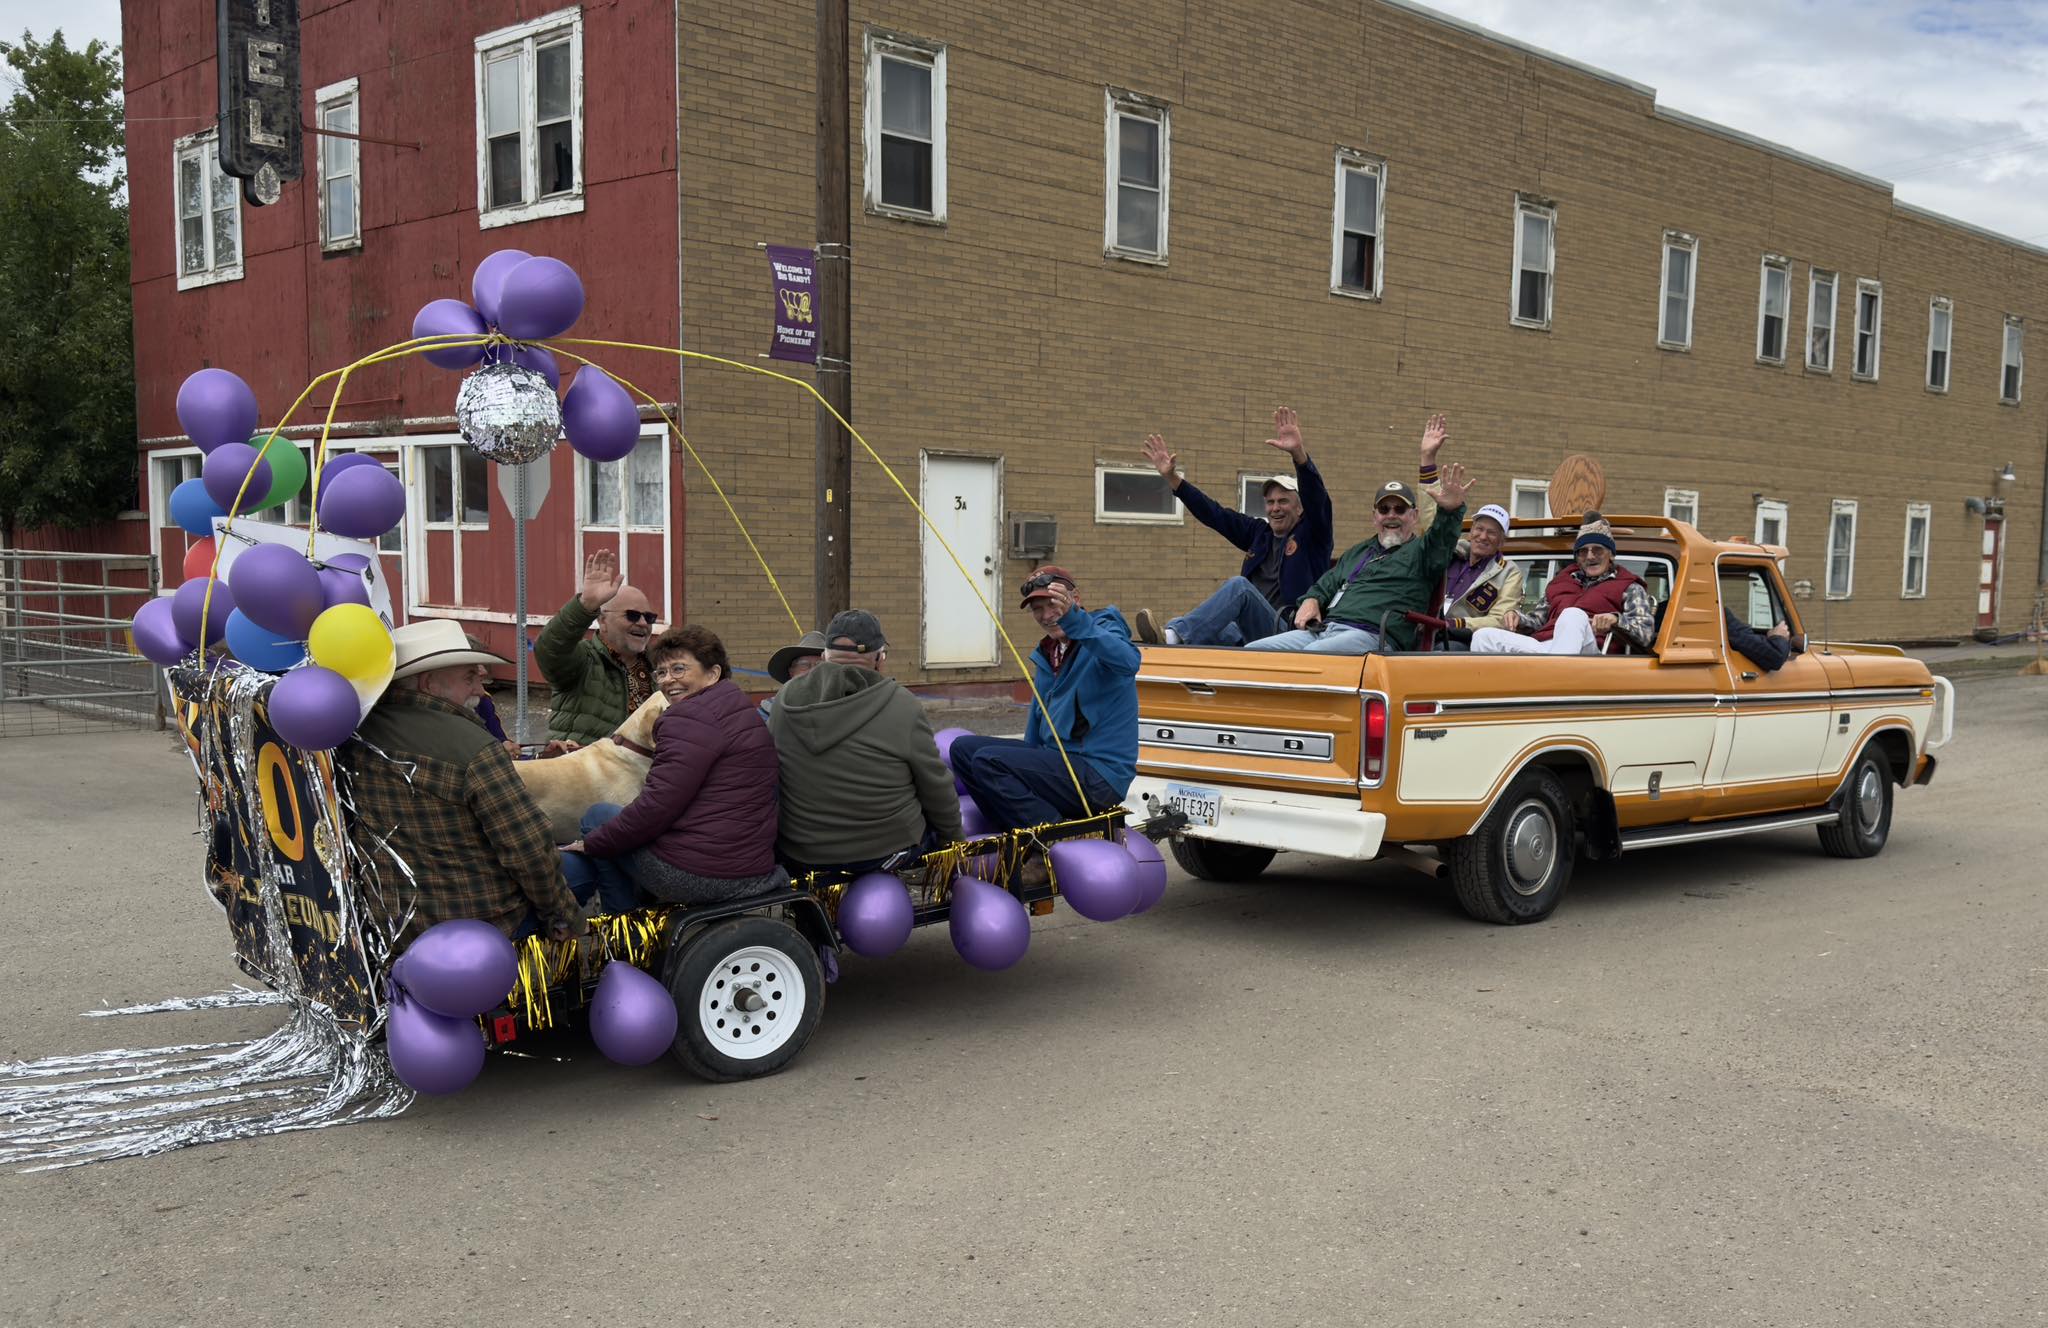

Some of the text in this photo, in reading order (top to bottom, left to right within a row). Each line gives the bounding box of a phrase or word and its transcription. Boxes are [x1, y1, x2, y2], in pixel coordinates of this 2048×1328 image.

[773, 262, 812, 276] WELCOME TO
[777, 271, 811, 284] BIG SANDY!
[777, 325, 795, 335] HOME
[780, 334, 812, 346] PIONEERS!
[1157, 727, 1304, 750] ORD
[1178, 787, 1206, 799] MONTANA
[274, 863, 296, 886] AR
